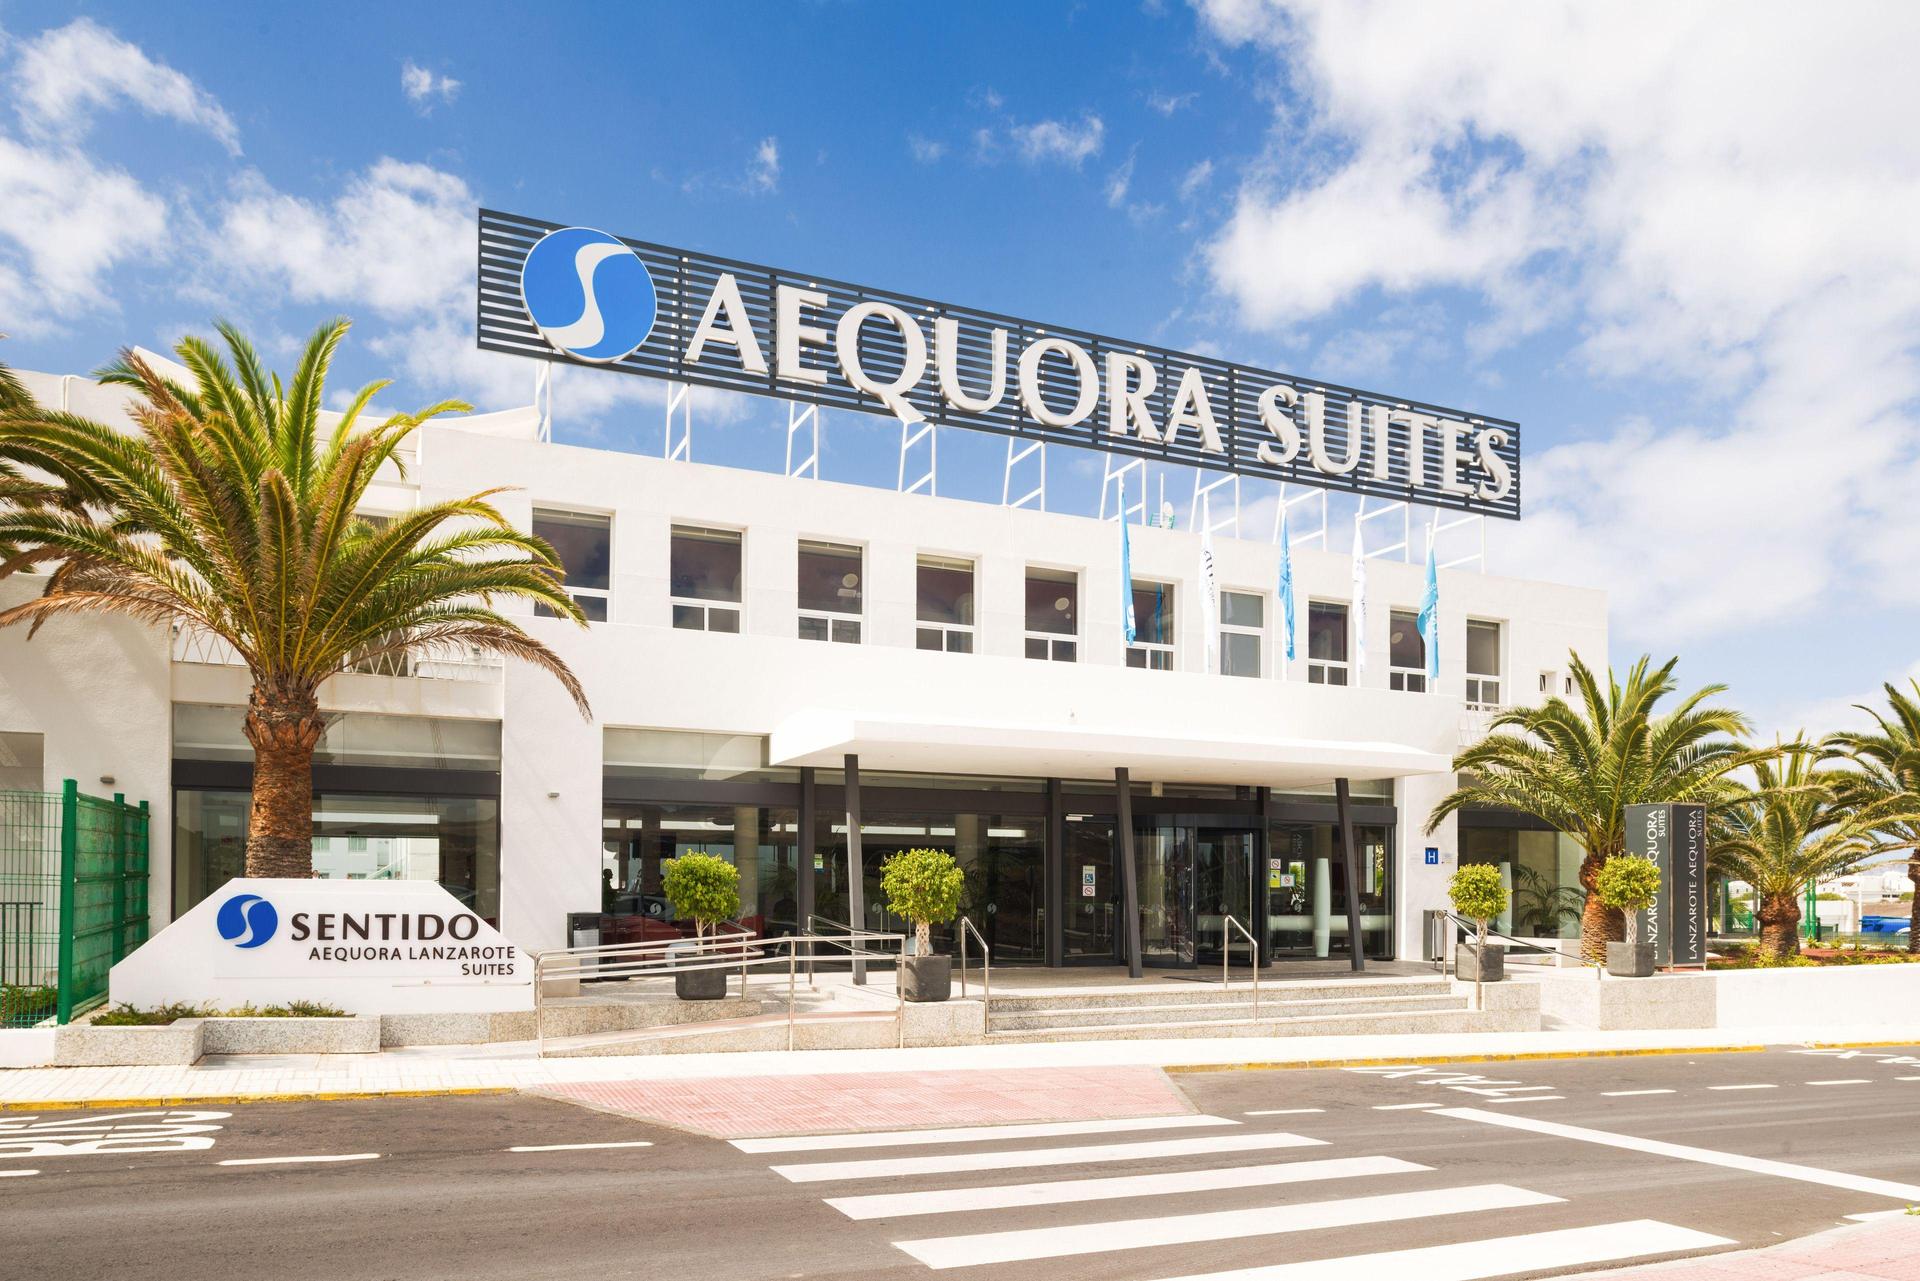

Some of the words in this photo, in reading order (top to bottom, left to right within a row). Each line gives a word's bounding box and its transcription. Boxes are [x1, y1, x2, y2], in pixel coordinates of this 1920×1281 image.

[683, 273, 926, 453] AEQUORA
[1257, 385, 1512, 502] SUITES
[1658, 809, 1666, 837] SUITES
[1428, 851, 1436, 864] H
[1688, 810, 1699, 877] AEQUORA
[291, 912, 479, 941] SENTIDO
[1689, 881, 1698, 960] LANZAROTE
[308, 946, 402, 963] AEQUORA
[408, 945, 516, 961] LANZAROTE
[461, 963, 515, 977] SUITES
